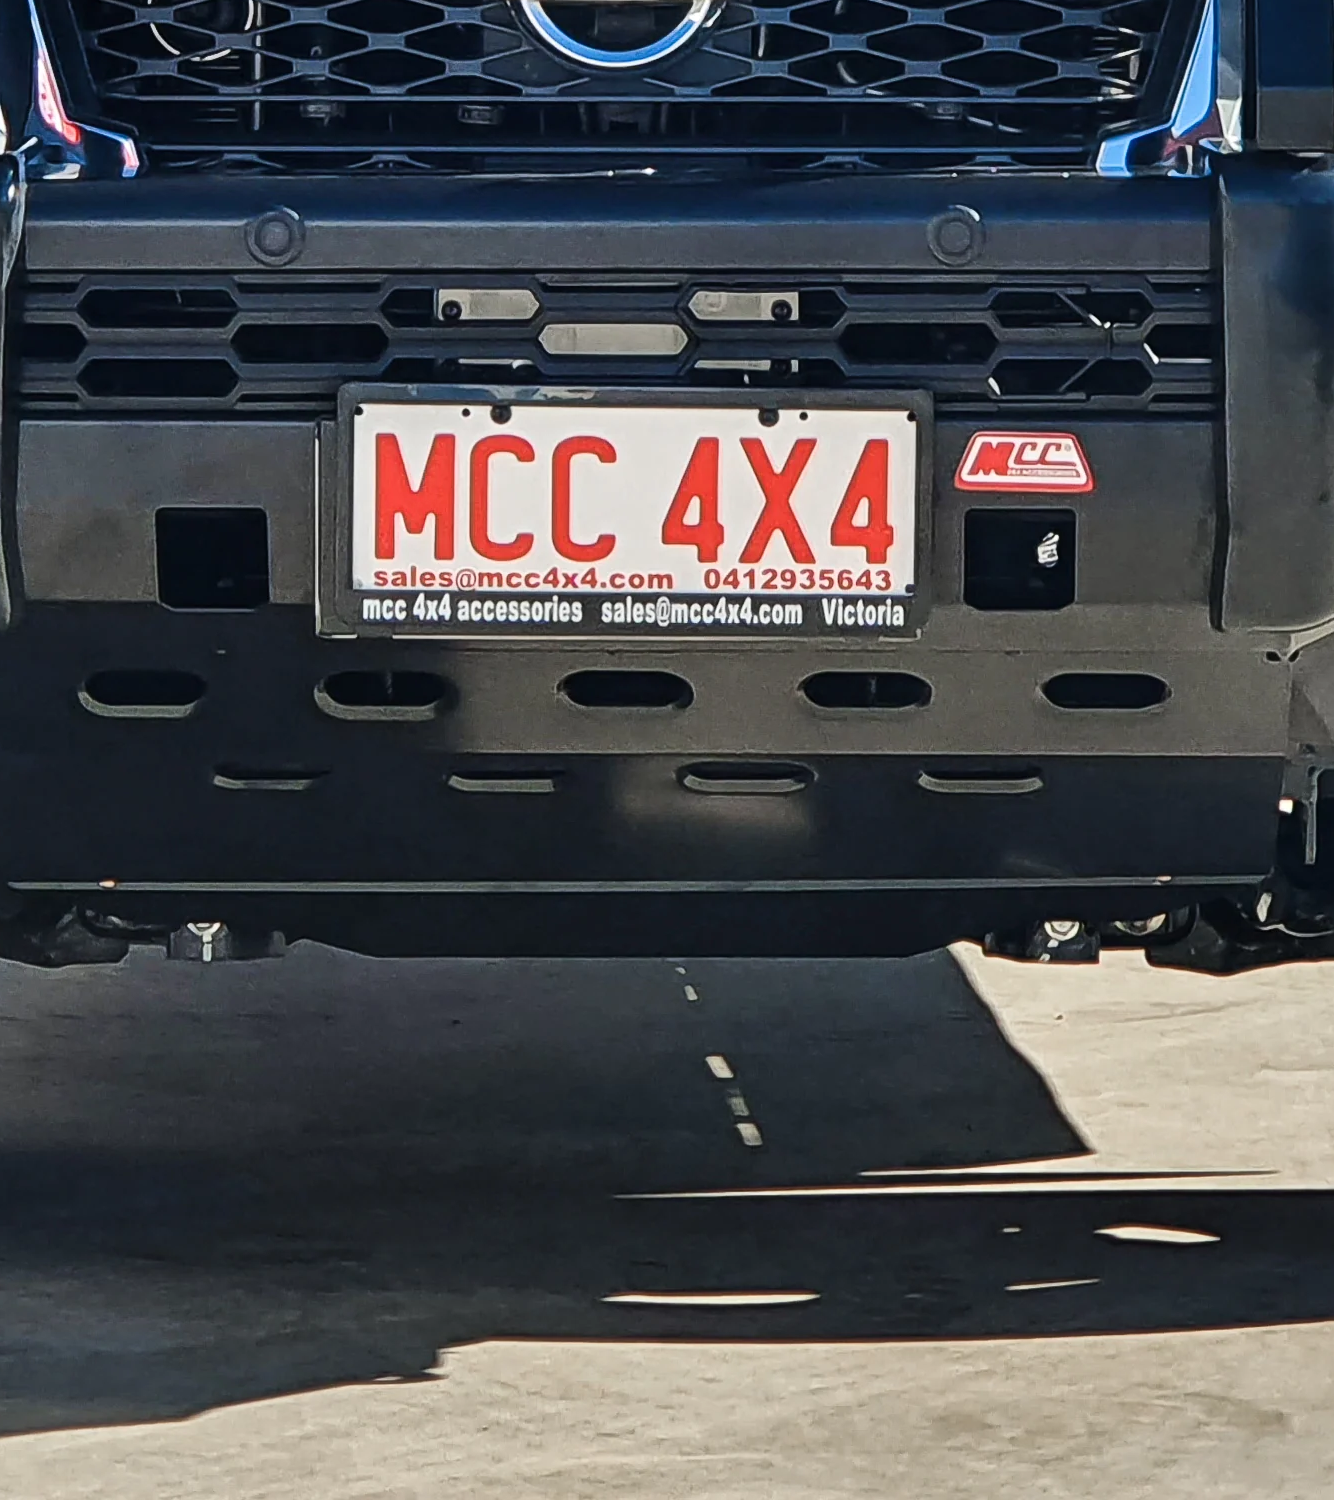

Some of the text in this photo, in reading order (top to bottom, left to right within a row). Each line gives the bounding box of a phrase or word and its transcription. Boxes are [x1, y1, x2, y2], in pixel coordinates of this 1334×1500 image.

[967, 441, 1077, 476] MCC
[374, 432, 895, 564] MCC 4X4
[373, 567, 893, 592] sales@mcc4x4.com 0412935643
[362, 596, 905, 627] mcc 4x4 accessories sales@mcc4x4.com Victoria
